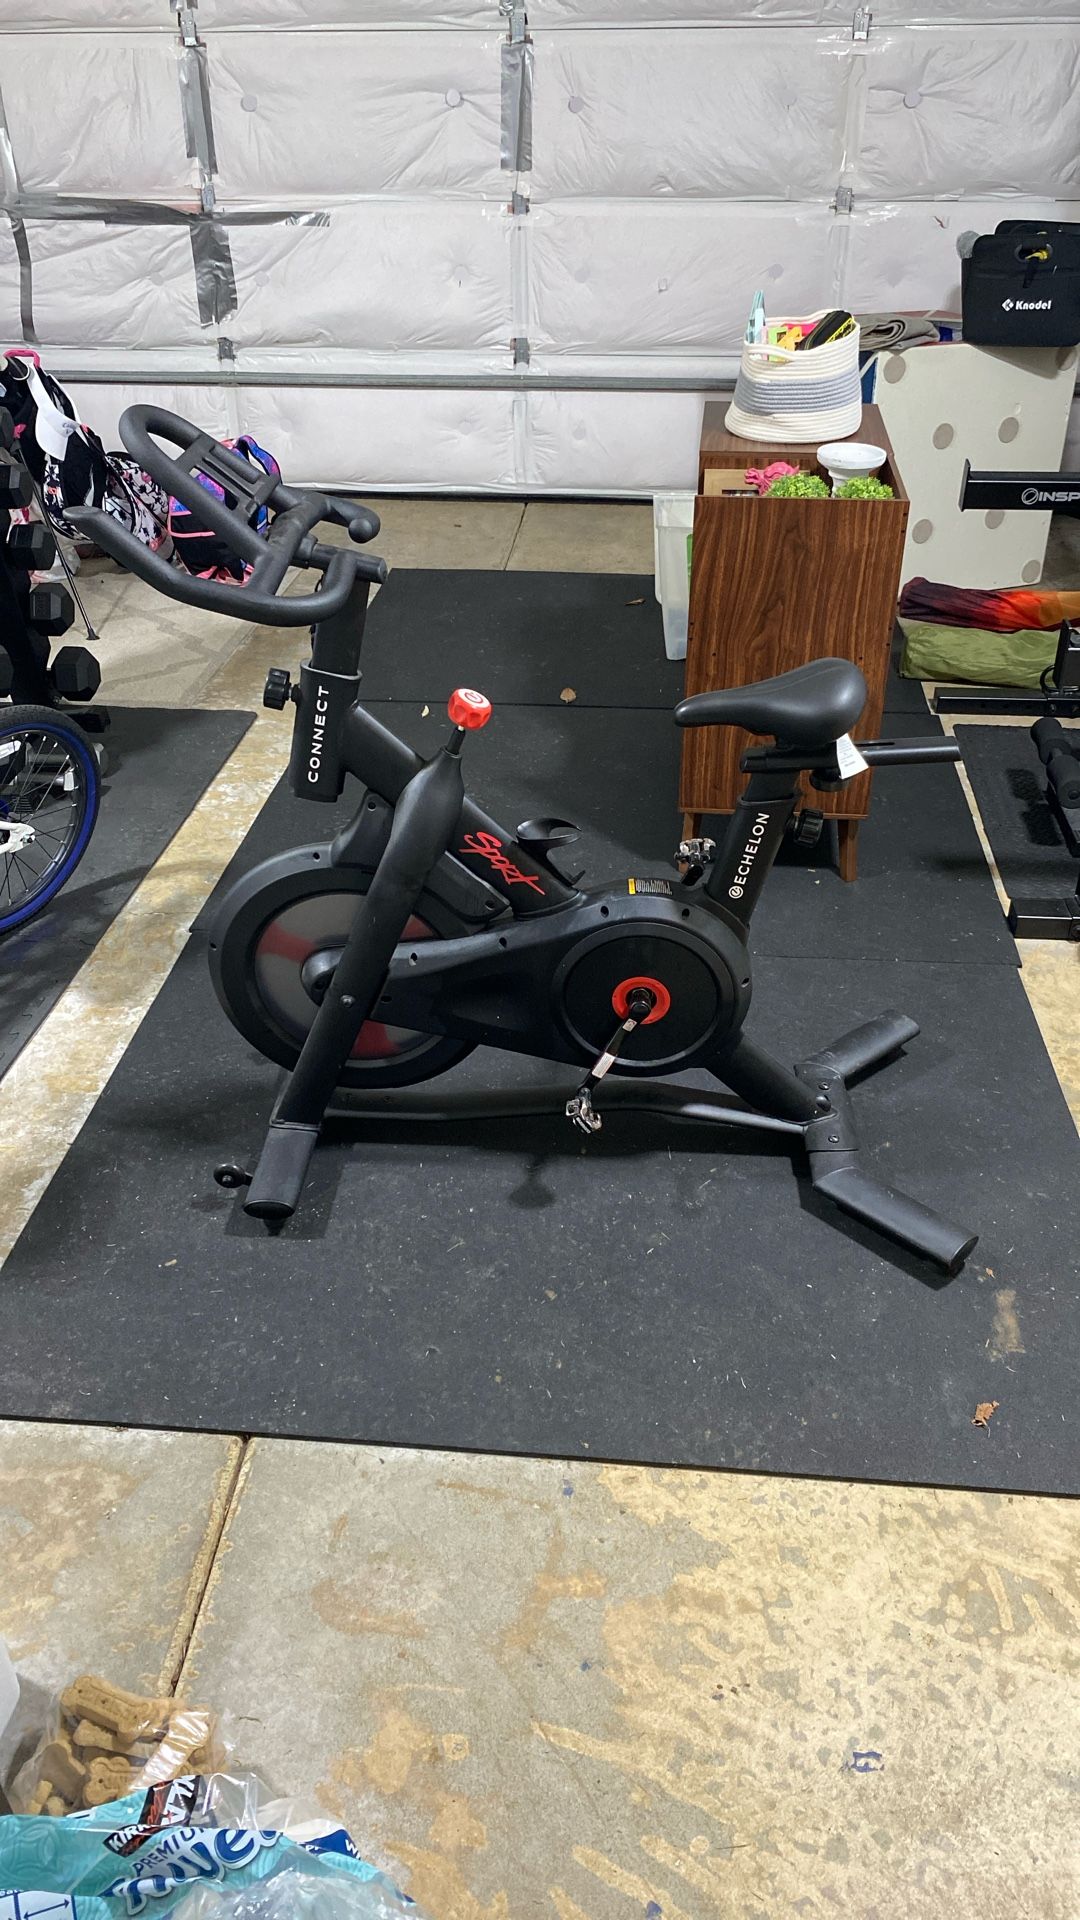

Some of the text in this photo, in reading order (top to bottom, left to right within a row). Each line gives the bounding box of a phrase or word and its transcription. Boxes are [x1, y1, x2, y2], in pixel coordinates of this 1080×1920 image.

[1015, 300, 1052, 310] Knodel
[1038, 491, 1080, 502] INSP
[307, 685, 330, 783] CONNECT
[733, 812, 770, 885] ECHELON
[132, 1828, 205, 1877] PREMIU
